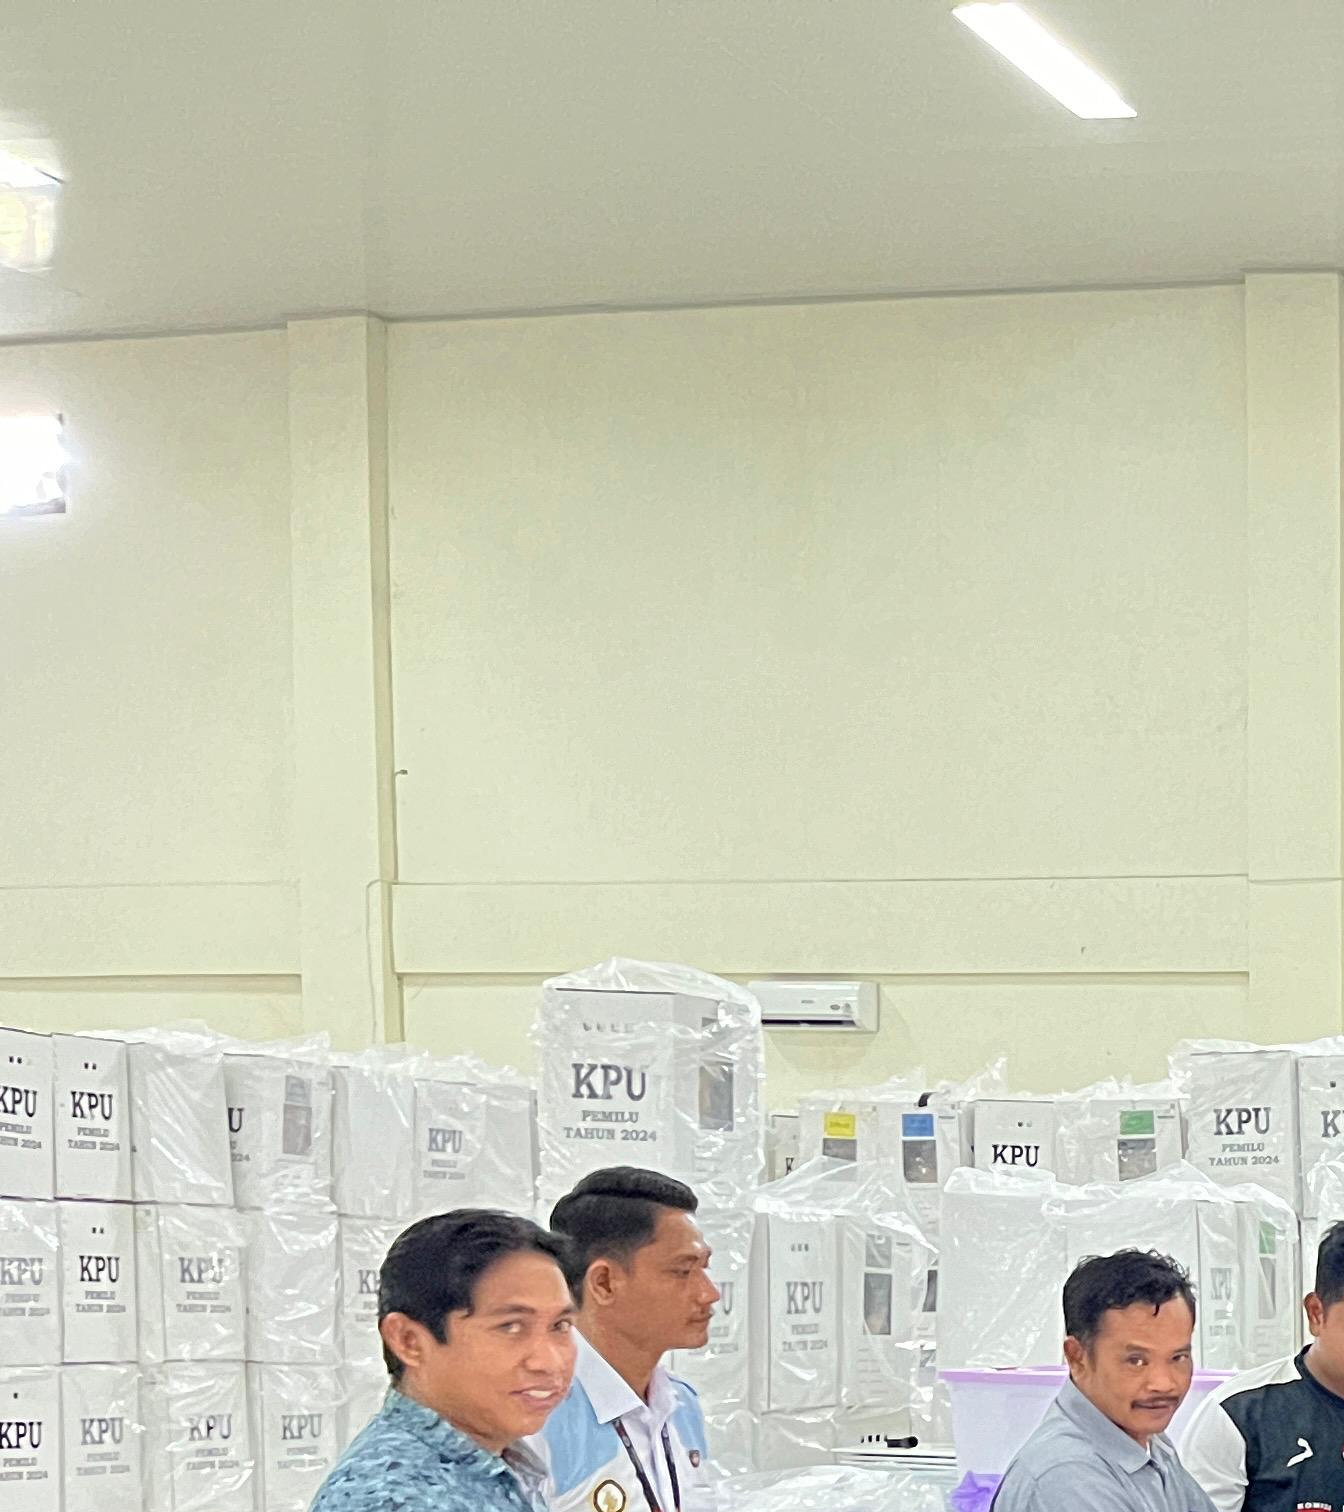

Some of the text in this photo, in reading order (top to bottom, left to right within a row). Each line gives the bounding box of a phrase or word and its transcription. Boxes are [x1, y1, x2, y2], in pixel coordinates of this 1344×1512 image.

[571, 1063, 646, 1101] KPU
[71, 1091, 113, 1121] KPU
[581, 1110, 639, 1123] PEMILU
[563, 1127, 656, 1141] TAHUN 2024
[1214, 1106, 1272, 1136] KPU
[428, 1127, 463, 1154] KPU
[1221, 1143, 1264, 1153] PEMILU
[992, 1144, 1040, 1167] KPU
[1209, 1155, 1280, 1166] TAHUN 2024
[0, 1257, 43, 1285] KPU
[79, 1255, 120, 1283] KPU
[178, 1256, 224, 1284] KPU
[786, 1281, 823, 1315] KPU
[0, 1421, 43, 1449] KPU
[80, 1417, 124, 1446] KPU
[188, 1413, 233, 1441] KPU
[281, 1413, 323, 1440] KPU
